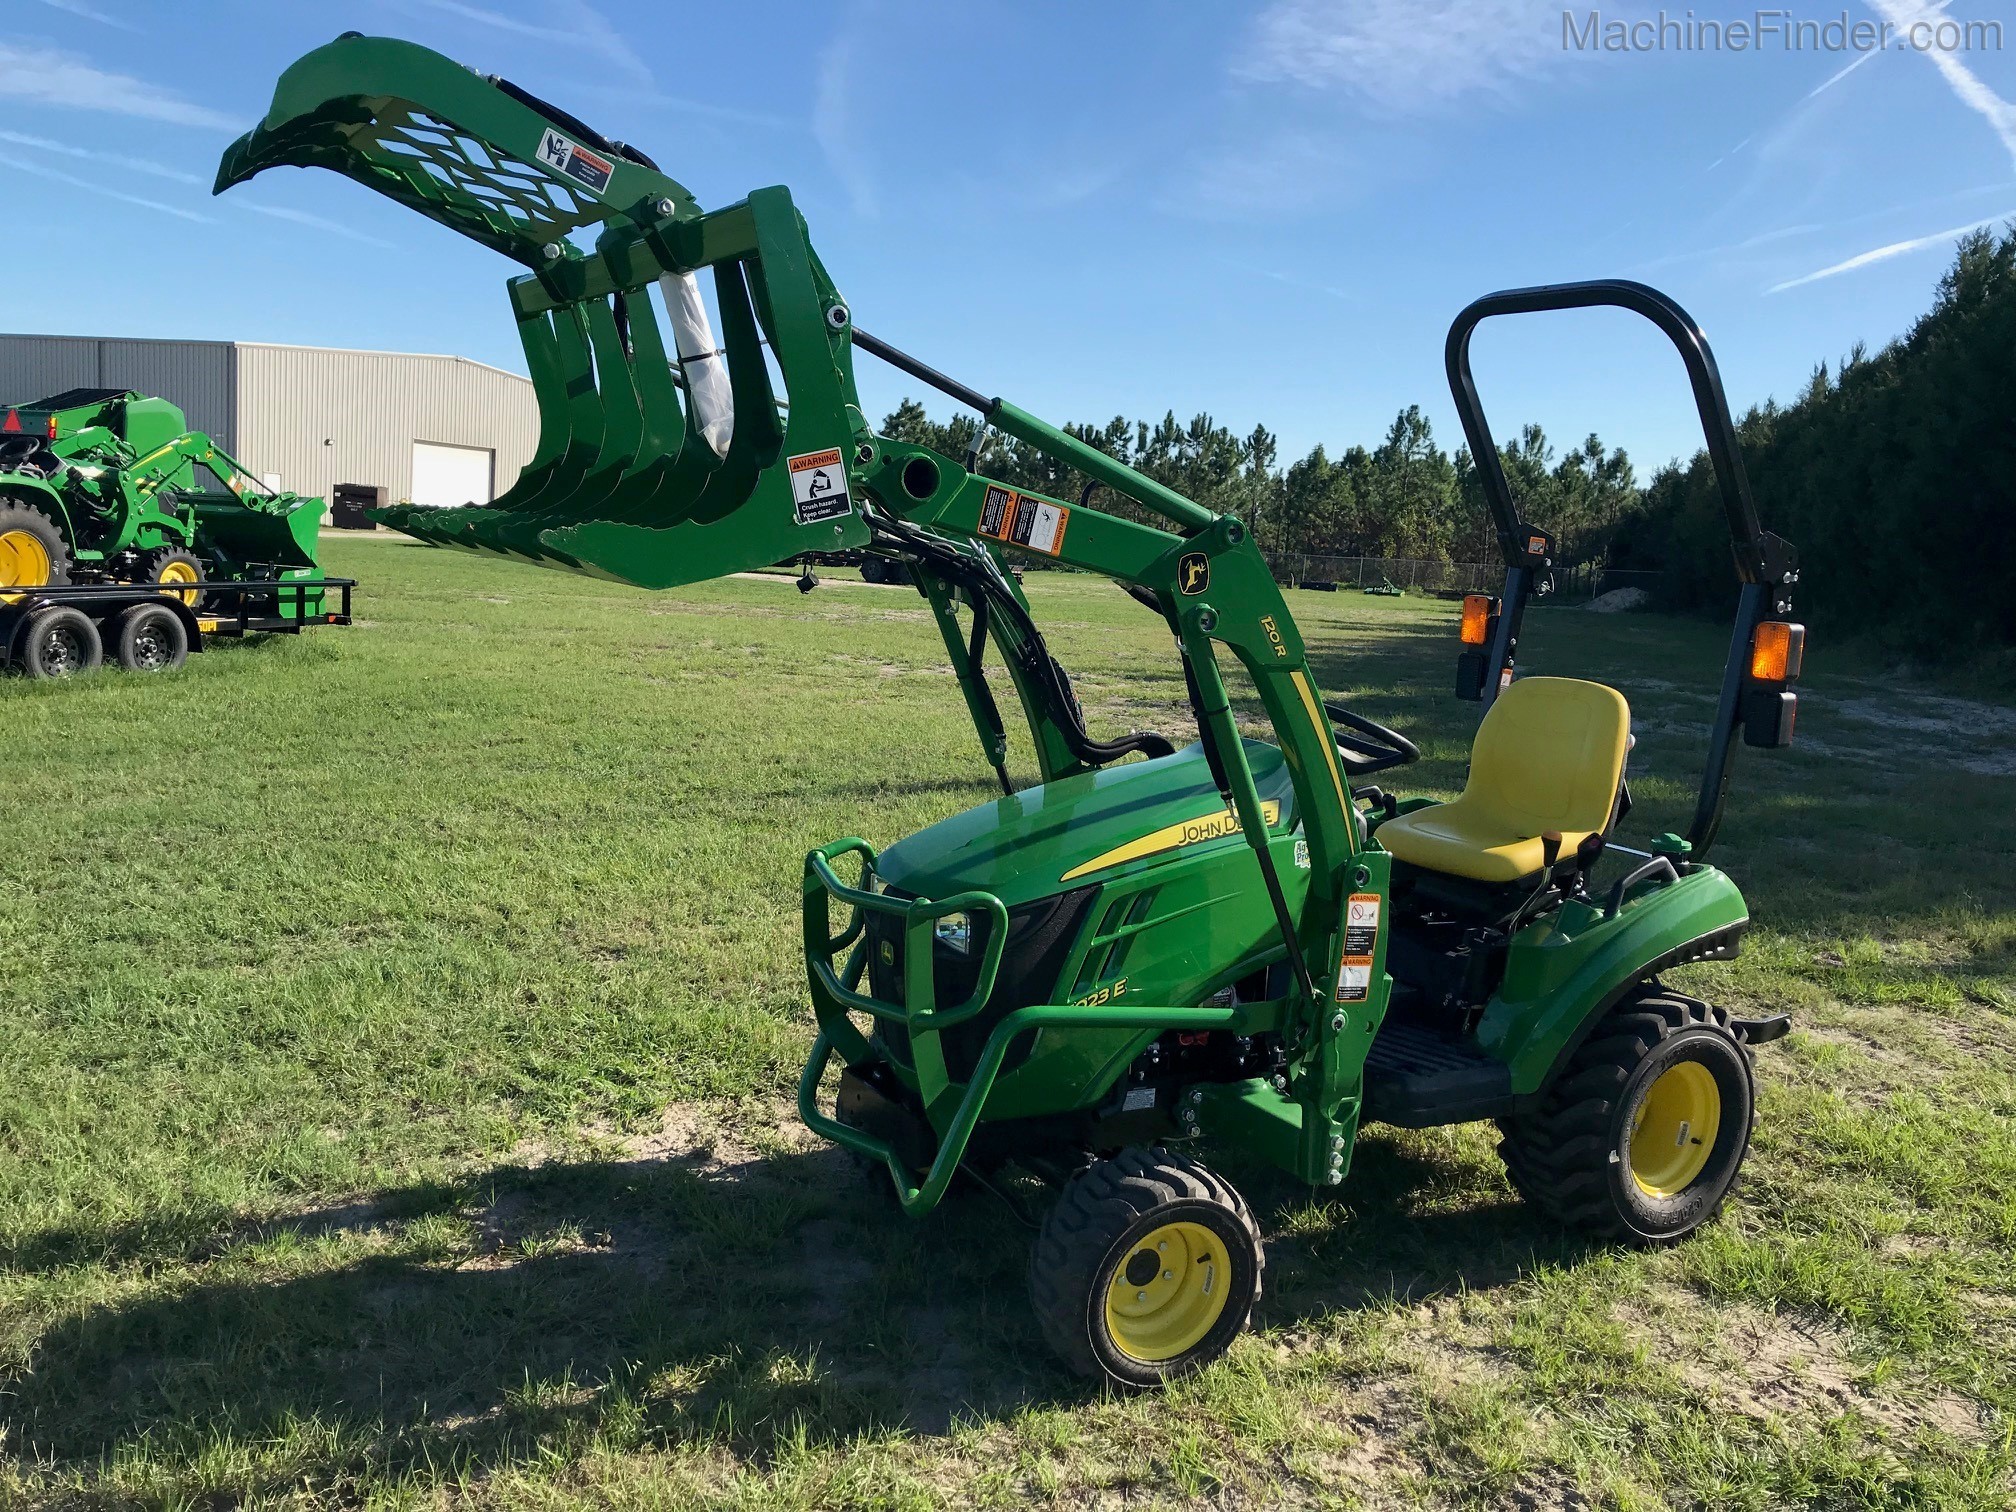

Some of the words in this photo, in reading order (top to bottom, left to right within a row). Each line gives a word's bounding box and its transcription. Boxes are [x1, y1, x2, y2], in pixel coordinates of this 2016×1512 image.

[581, 153, 609, 171] WARNING
[799, 453, 838, 467] WARNING
[801, 502, 818, 511] Crush
[818, 499, 839, 508] hazard.
[803, 510, 818, 518] Keep
[1001, 506, 1013, 535] WARNING
[1053, 521, 1065, 551] WARNING
[1260, 616, 1280, 644] 120
[1274, 645, 1287, 658] R
[1179, 821, 1222, 844] JOHN
[1113, 978, 1127, 998] E
